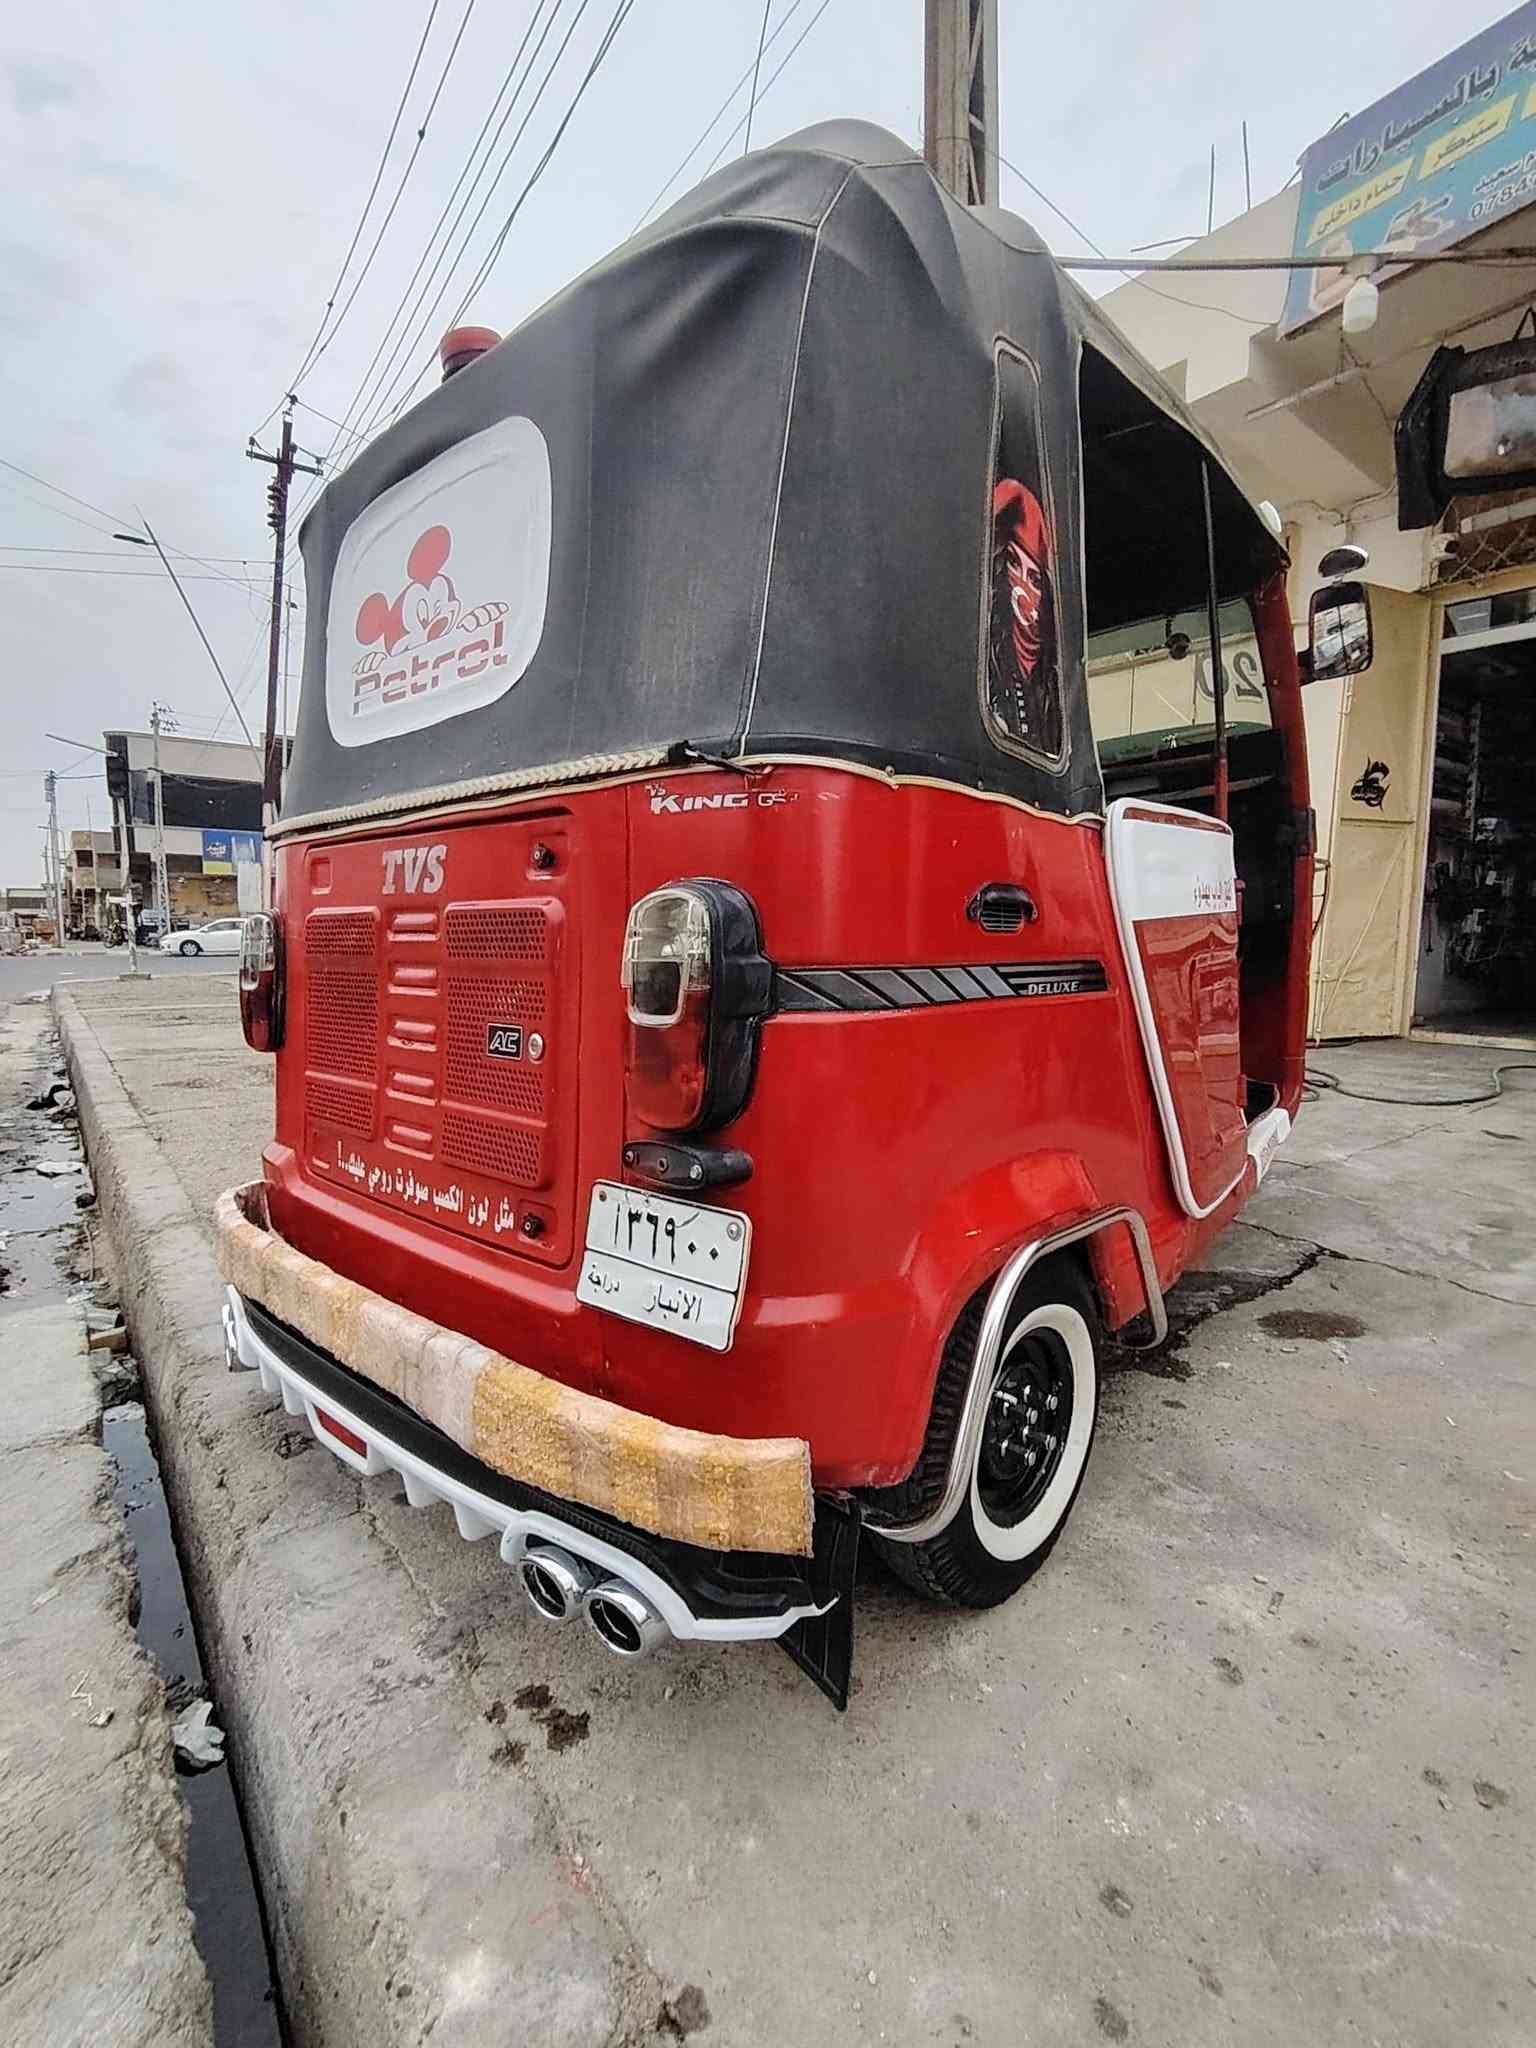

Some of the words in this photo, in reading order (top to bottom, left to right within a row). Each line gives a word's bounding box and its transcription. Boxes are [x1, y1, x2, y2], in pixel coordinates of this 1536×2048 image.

[1317, 62, 1500, 193] بالسيارات
[1471, 172, 1536, 218] 0784
[650, 792, 749, 815] KING
[382, 844, 448, 894] TVS
[1027, 980, 1081, 996] DELUXE
[489, 1030, 519, 1053] AC
[368, 1166, 392, 1194] روحي
[467, 1194, 490, 1227] لون
[493, 1196, 515, 1233] مثل
[587, 1263, 621, 1295] دراجة
